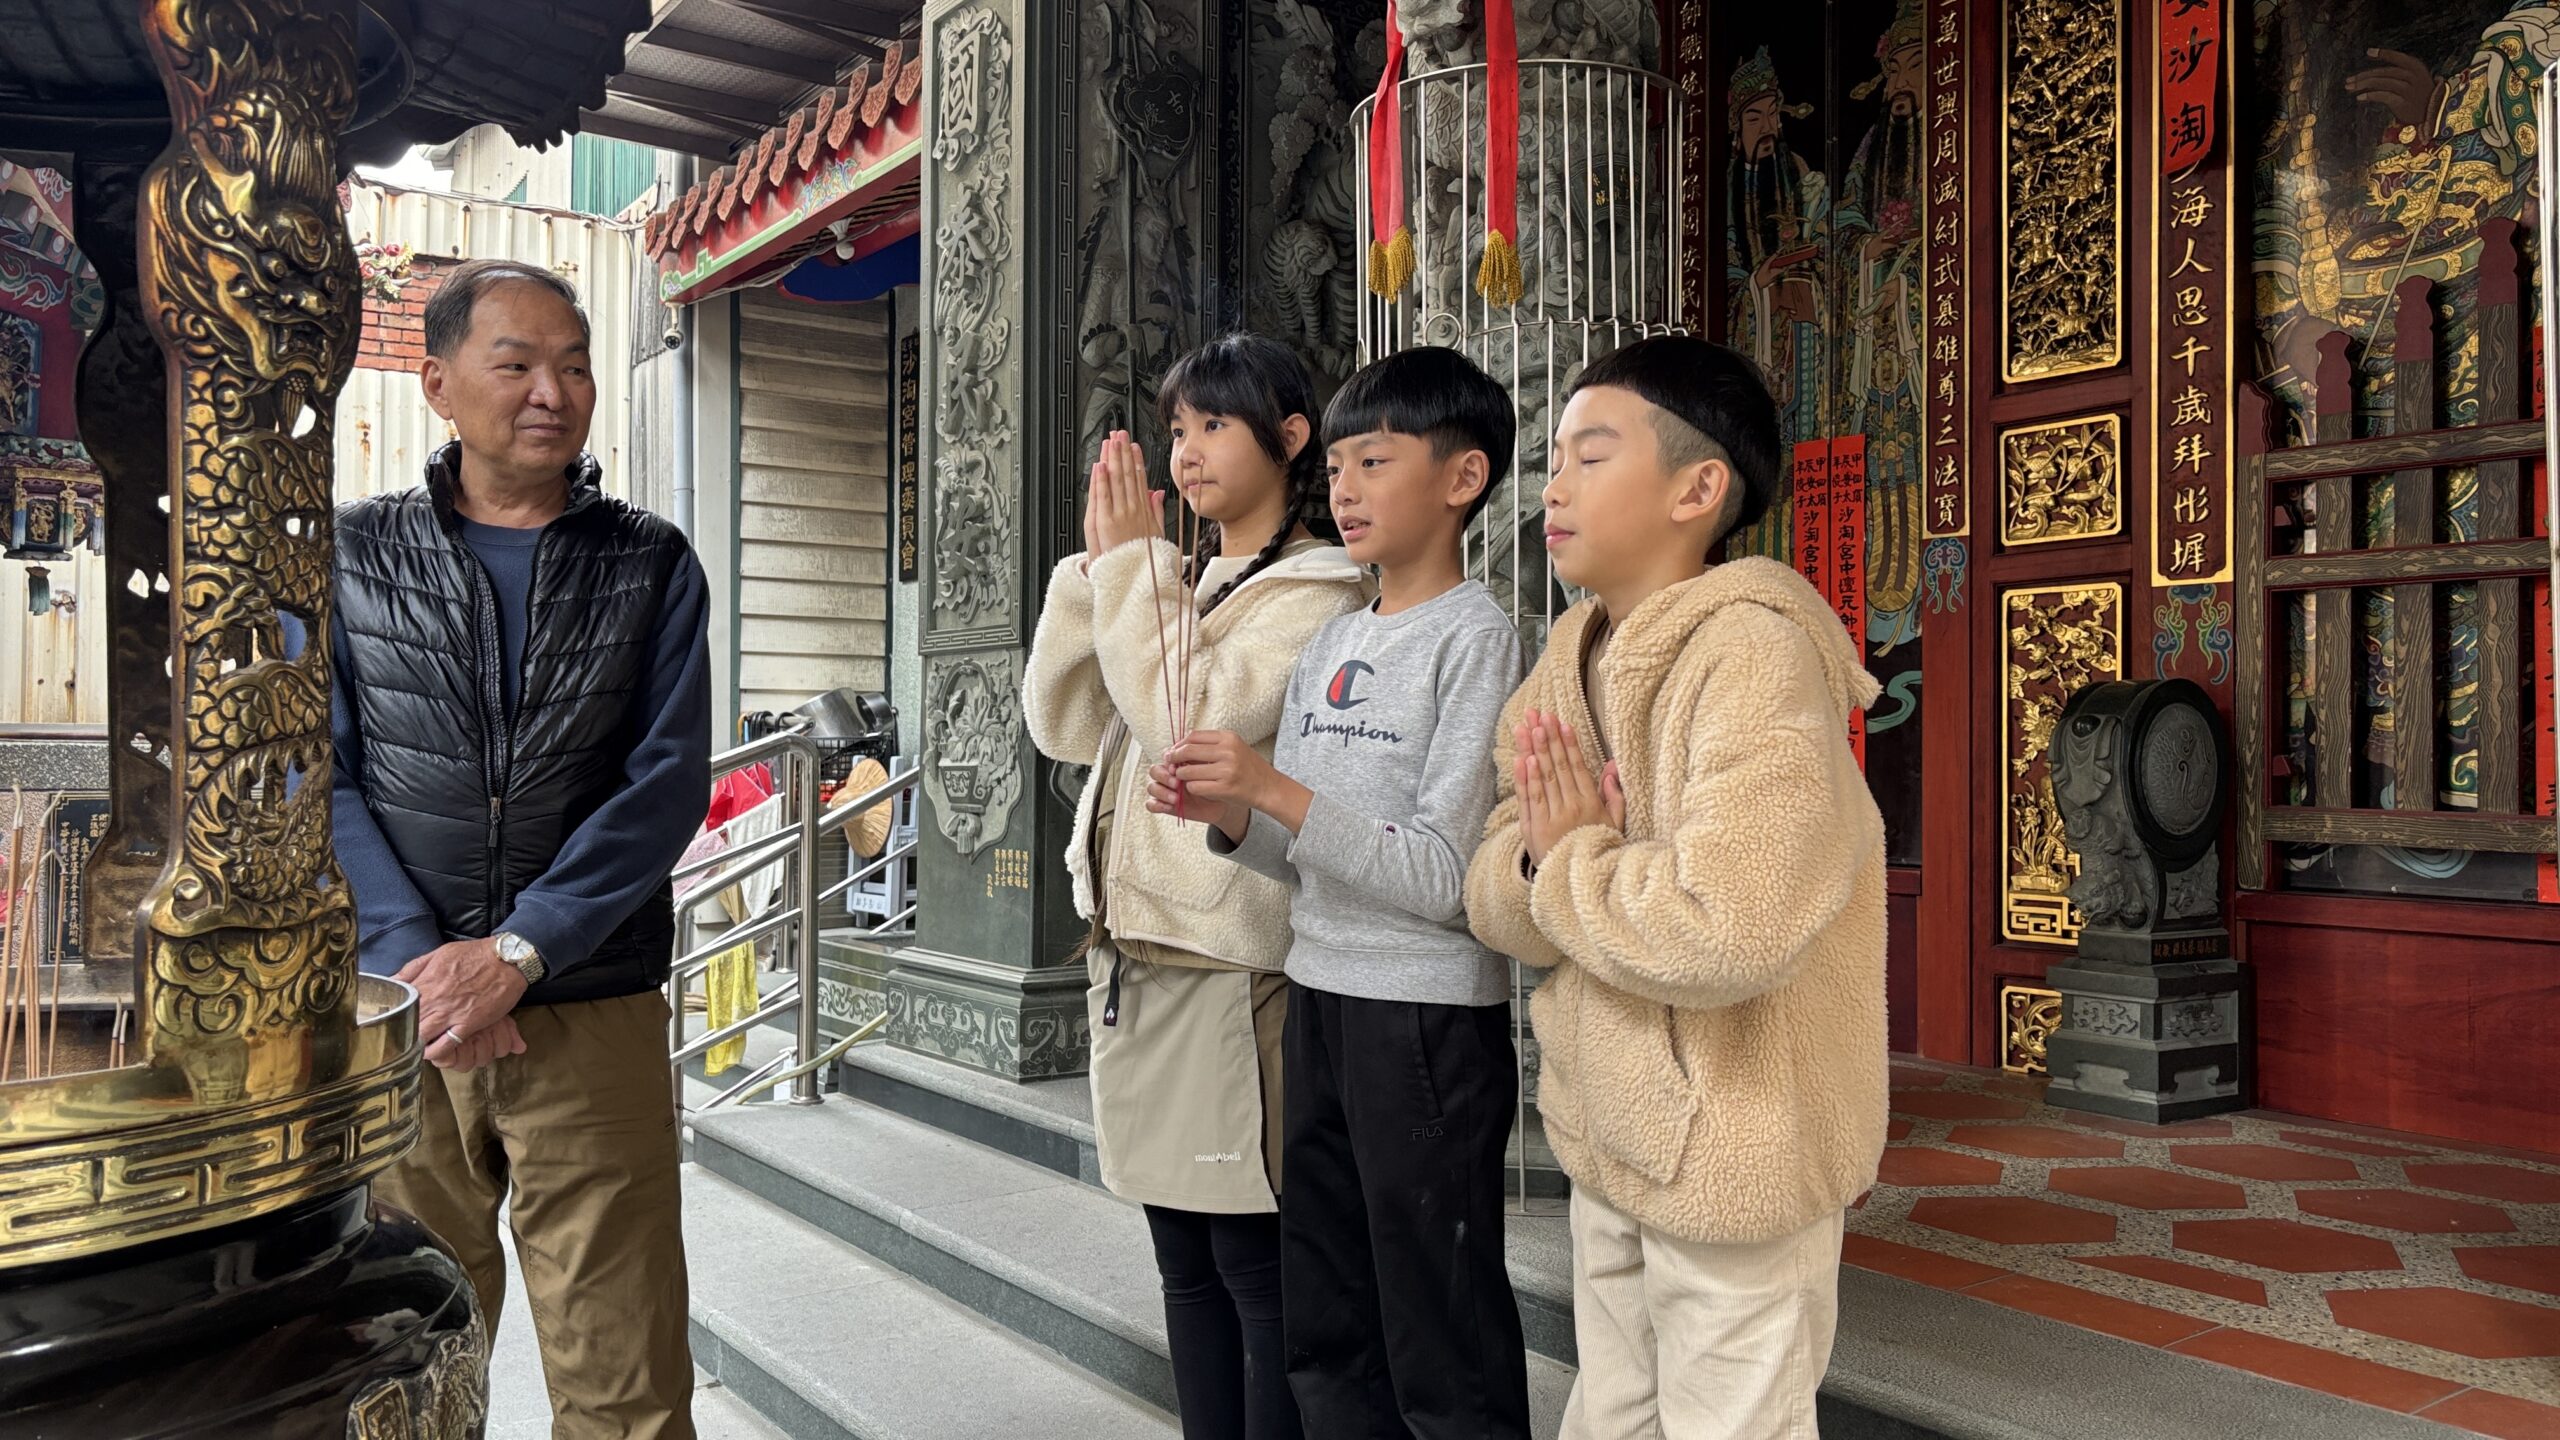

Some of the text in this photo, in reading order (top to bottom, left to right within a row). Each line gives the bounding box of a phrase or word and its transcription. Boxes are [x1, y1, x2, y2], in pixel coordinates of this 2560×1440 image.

[2165, 0, 2213, 157] 沙淘
[1933, 0, 1961, 527] 萬世興周滅紂武篡雄尊三法寶
[2168, 160, 2213, 574] 海人思千歲拜彤墀
[1300, 712, 1402, 747] Champion
[1411, 1126, 1444, 1140] FILA
